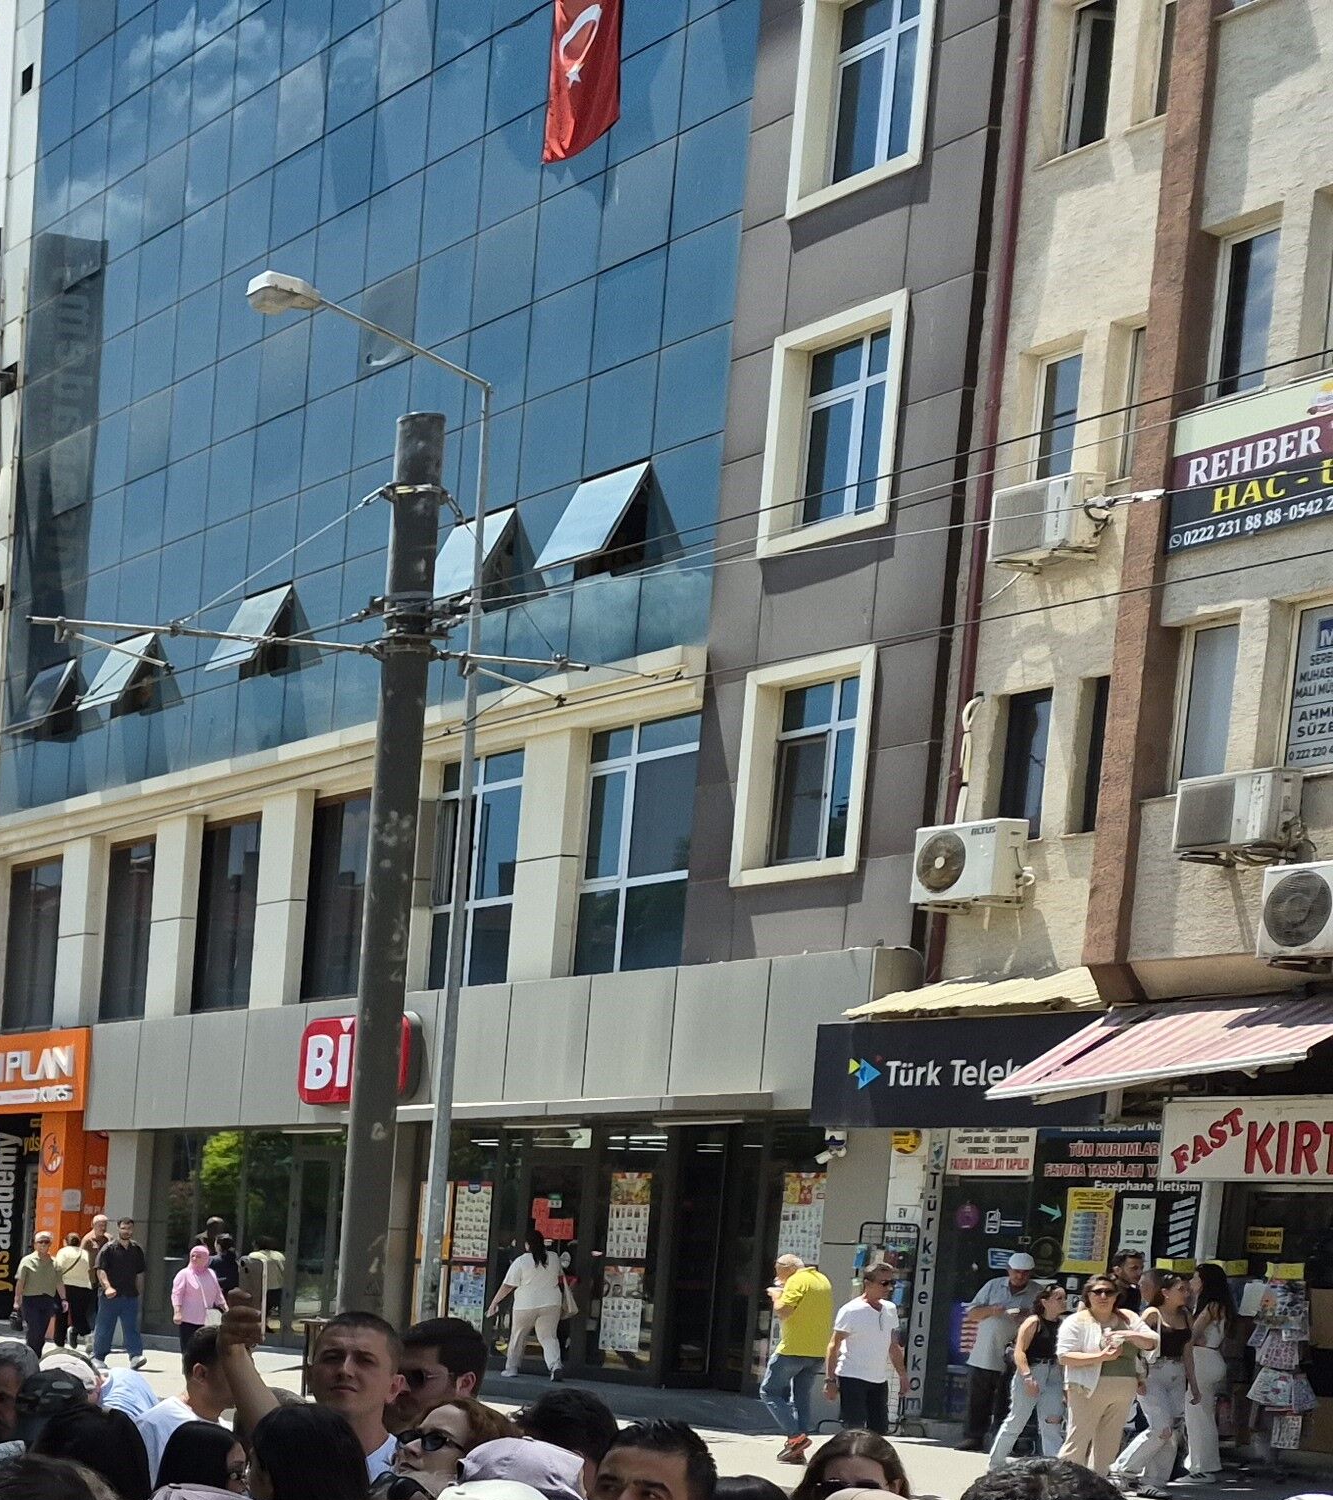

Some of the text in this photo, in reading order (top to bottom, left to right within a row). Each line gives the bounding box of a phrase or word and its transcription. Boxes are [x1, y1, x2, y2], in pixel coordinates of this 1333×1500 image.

[1187, 425, 1322, 487] REHBER
[1211, 470, 1288, 514] HAC
[1183, 525, 1215, 546] 0222
[1216, 517, 1240, 535] 231
[1245, 513, 1262, 530] 88
[304, 1016, 355, 1091] Bİ
[885, 1058, 1023, 1087] Türk Telek
[1069, 1139, 1094, 1158] TÜM
[1171, 1107, 1244, 1174] FAST
[1044, 1163, 1086, 1178] FATURA
